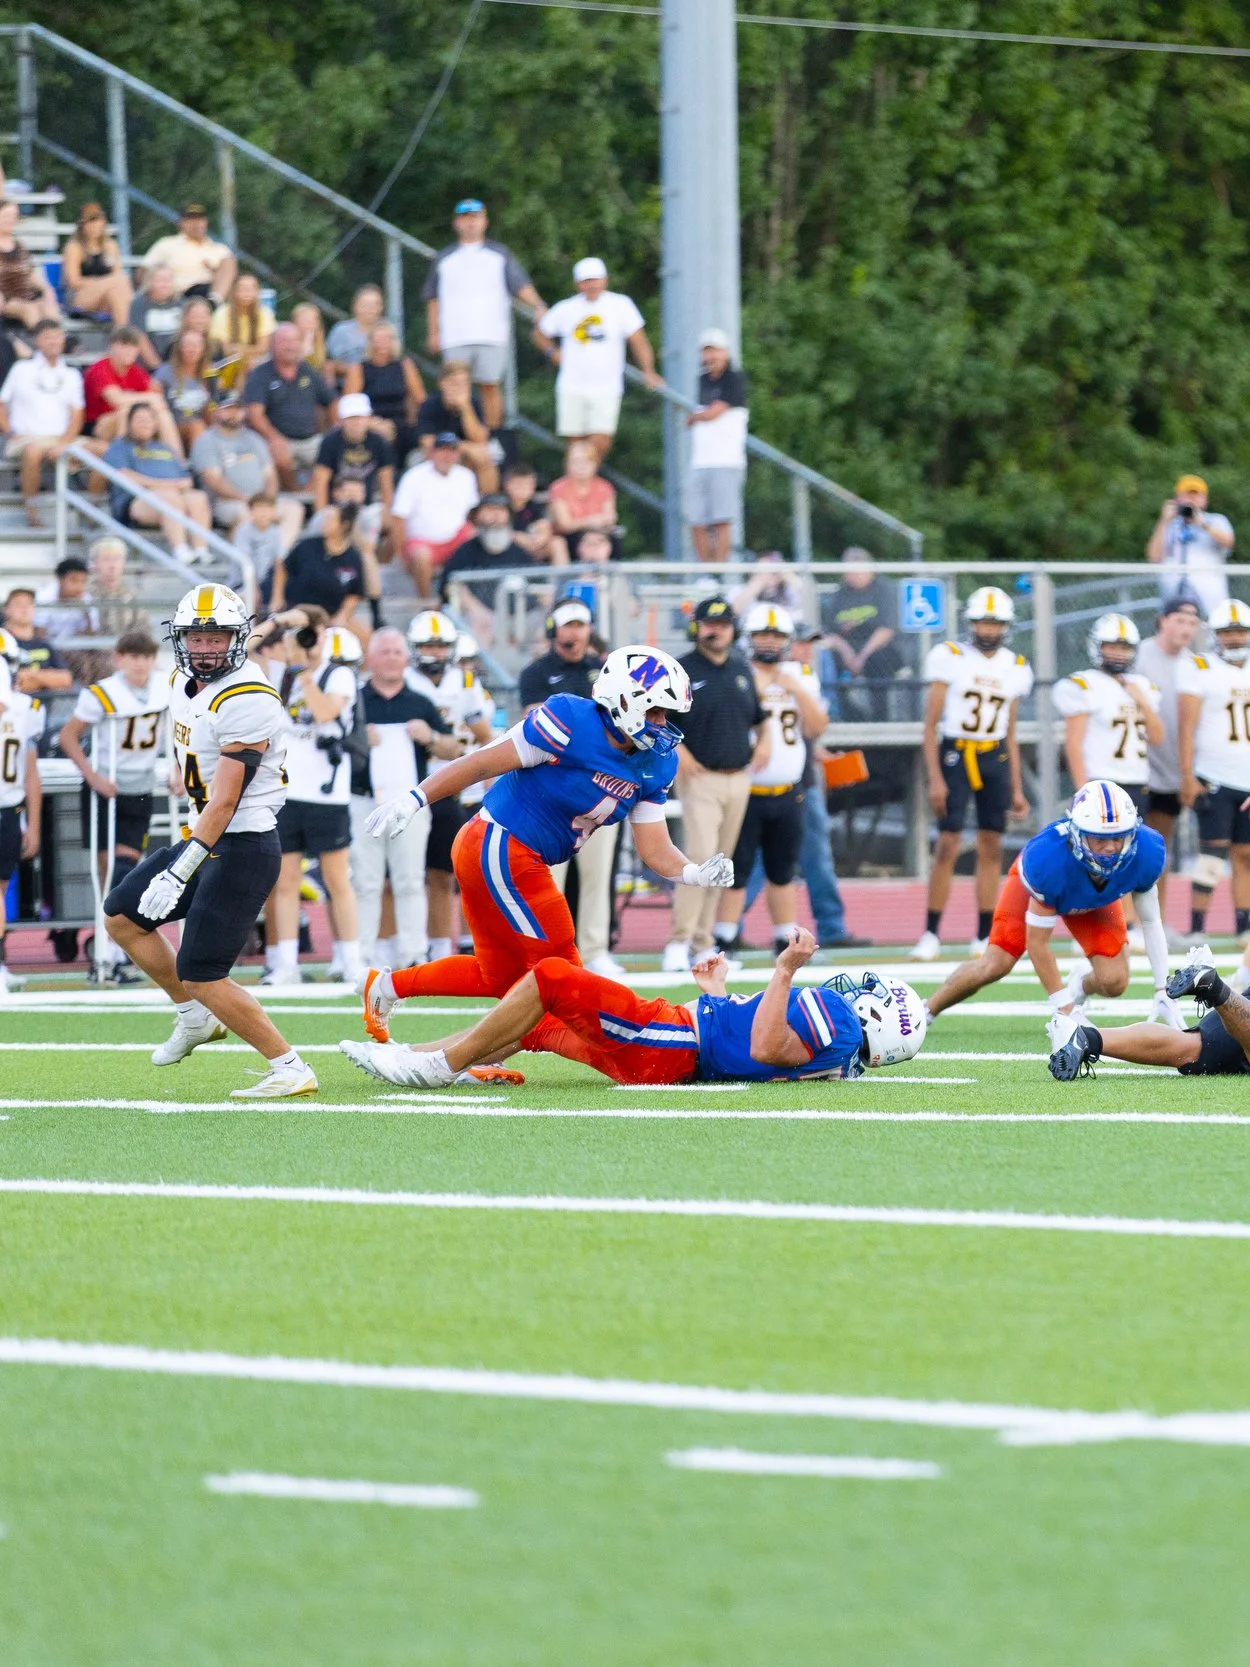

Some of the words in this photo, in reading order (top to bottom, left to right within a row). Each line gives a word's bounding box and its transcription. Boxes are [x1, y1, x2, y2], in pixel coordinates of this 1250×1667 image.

[628, 654, 669, 692] N
[119, 711, 161, 750] 13
[961, 691, 1006, 734] 37
[592, 771, 641, 800] BRUINS
[571, 795, 621, 850] 4
[891, 986, 913, 1037] Bruins
